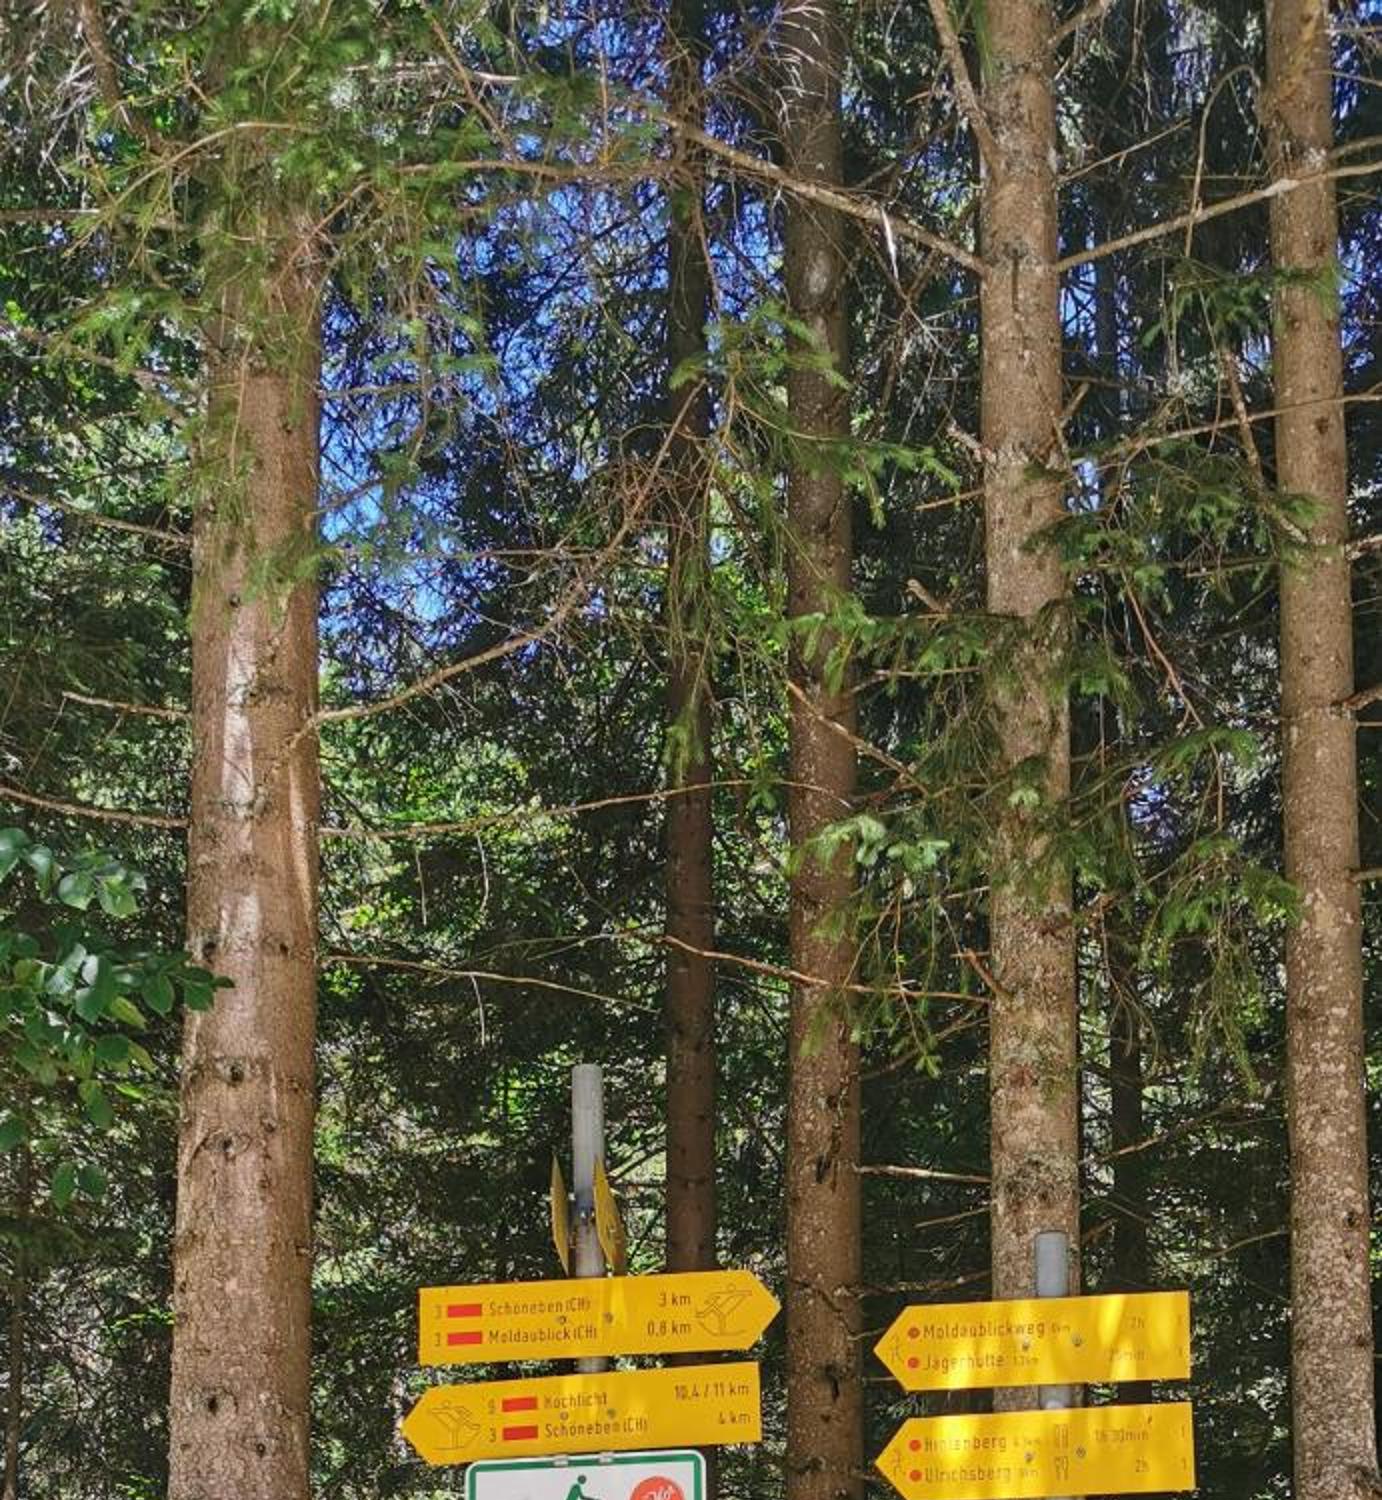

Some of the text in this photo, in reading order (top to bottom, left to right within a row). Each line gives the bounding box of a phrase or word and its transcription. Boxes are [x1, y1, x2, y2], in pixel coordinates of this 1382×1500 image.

[672, 1292, 691, 1307] km
[672, 1320, 691, 1335] km
[729, 1382, 750, 1397] km
[729, 1410, 751, 1425] km
